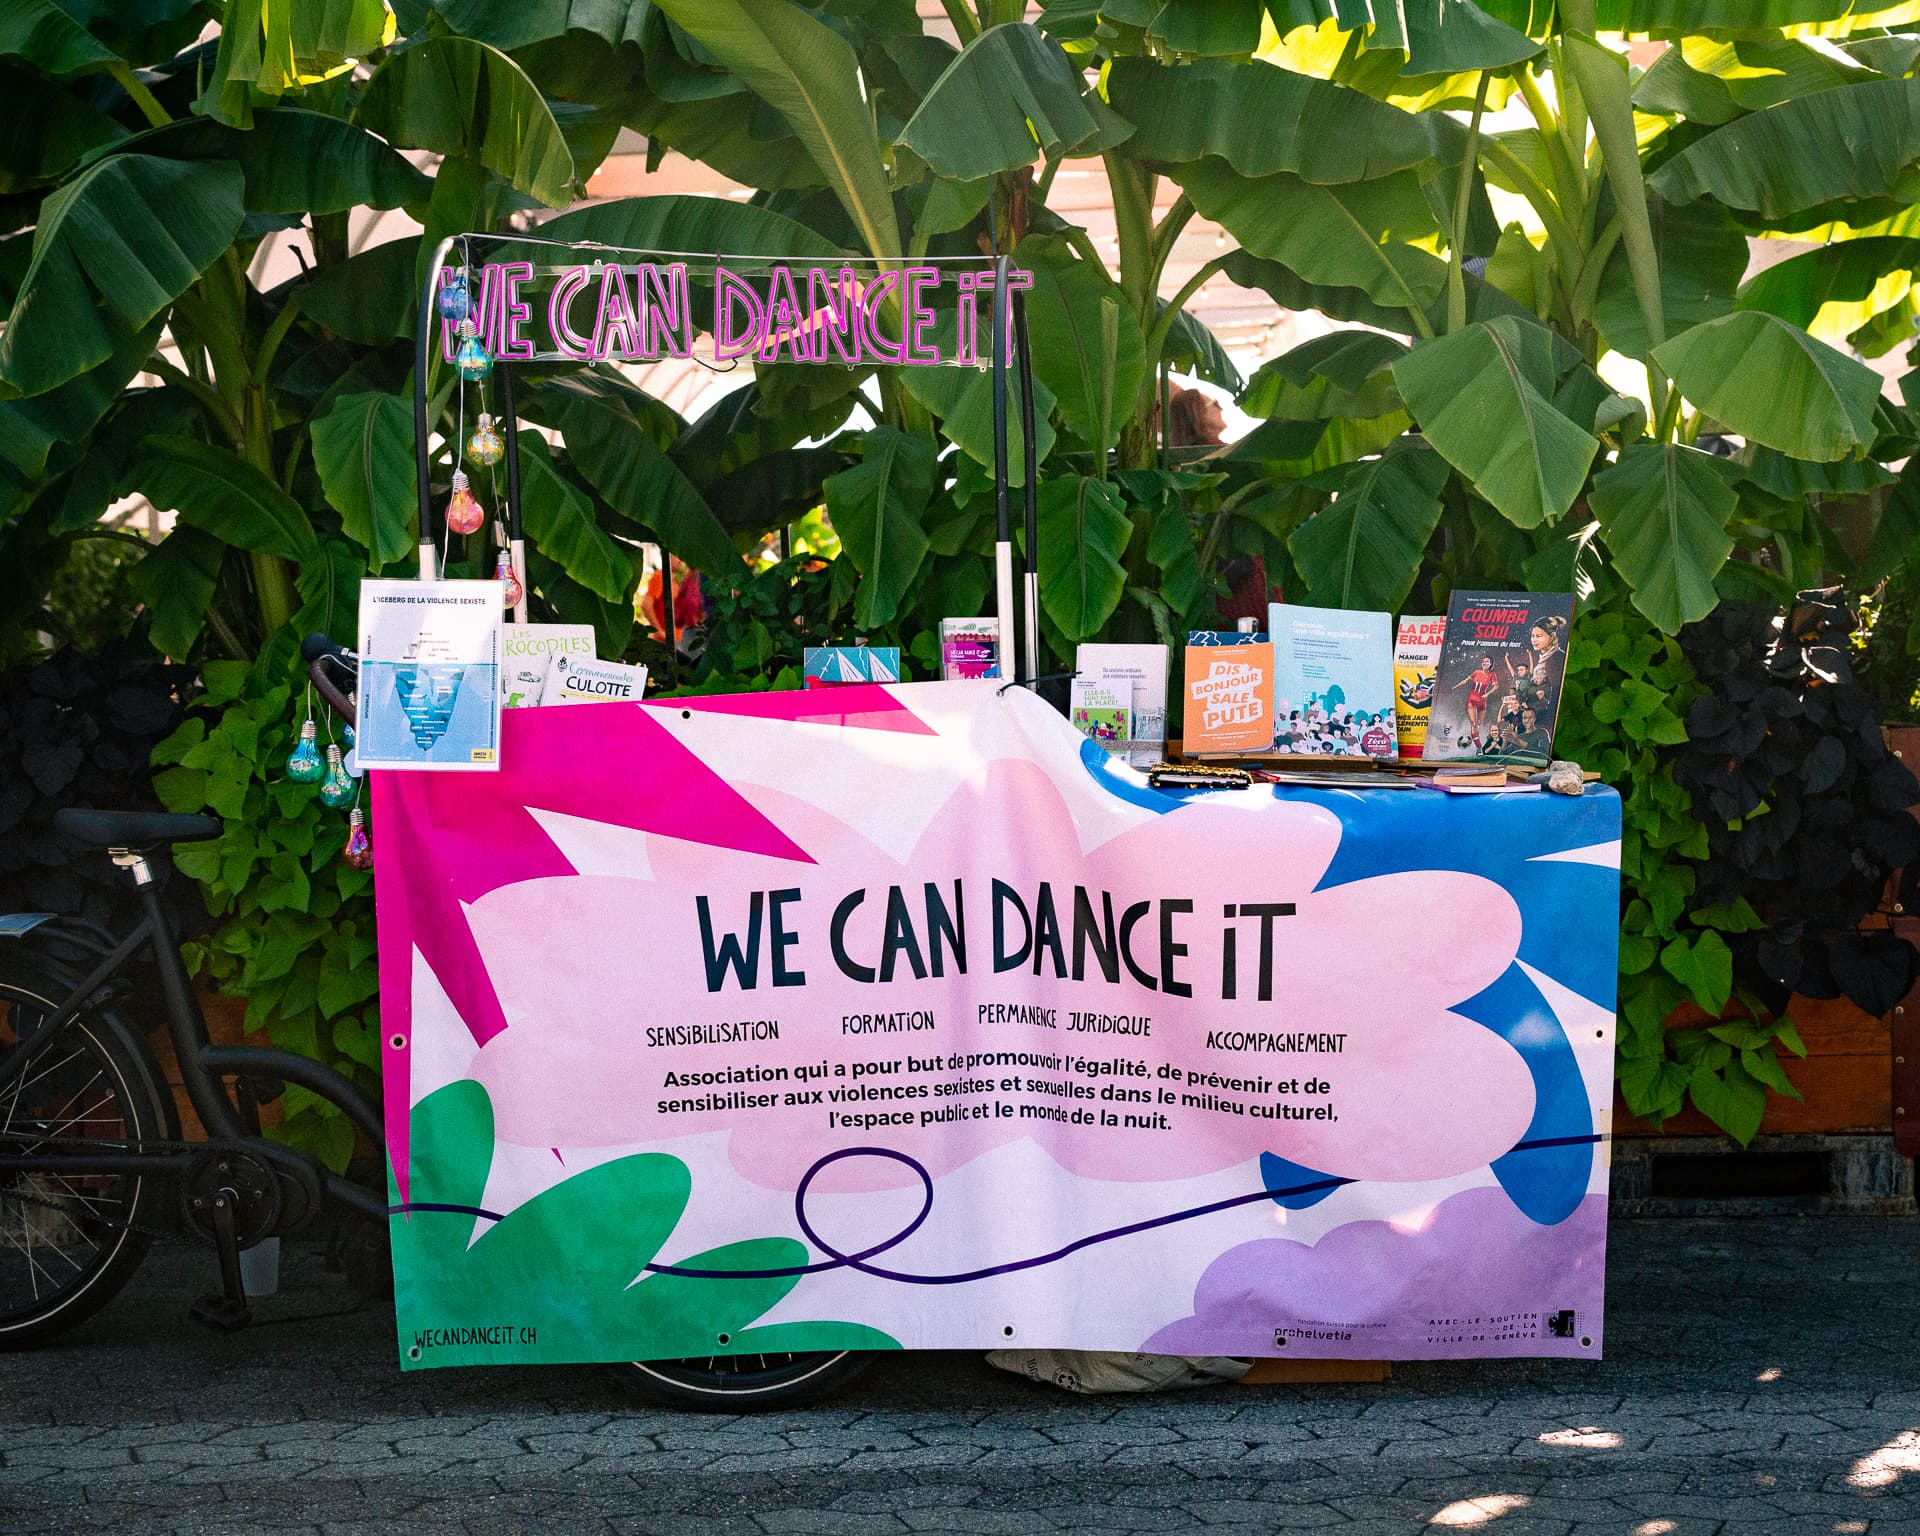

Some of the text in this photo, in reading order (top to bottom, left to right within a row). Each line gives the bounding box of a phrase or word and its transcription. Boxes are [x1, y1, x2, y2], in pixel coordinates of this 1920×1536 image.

[548, 262, 693, 361] CAN
[714, 265, 941, 365] DANCE
[373, 596, 405, 604] L'ICEBERG
[1461, 608, 1529, 624] COUMBA
[1398, 623, 1416, 634] LA
[1473, 624, 1510, 639] SOW
[505, 637, 591, 656] ROCODILES
[1215, 665, 1240, 675] DIS
[566, 676, 632, 697] CULOTTE
[1195, 673, 1258, 695] BONJOUR
[1210, 692, 1250, 704] SALE
[1207, 702, 1259, 727] PUTE
[696, 887, 807, 993] WE
[829, 877, 968, 984] CAN
[991, 877, 1194, 998] DANCE
[978, 1003, 1057, 1030] PERMANENCE
[1206, 1030, 1348, 1053] ACCOMPAGNEMENT
[664, 1065, 789, 1088] Association
[794, 1060, 829, 1083] qui
[834, 1063, 846, 1076] a
[852, 1060, 902, 1080] pour
[907, 1055, 944, 1073] but
[948, 1052, 964, 1070] de
[966, 1048, 1062, 1072] promouvoir
[1157, 1062, 1183, 1081] de
[1187, 1070, 1273, 1094] prévenir
[1278, 1079, 1299, 1094] et
[1304, 1077, 1331, 1094] de
[657, 1075, 1338, 1123] sensibiliser aux violences sexistes et sexuelles dans le milieu culturel,
[920, 1103, 969, 1128] public
[972, 1103, 990, 1119] et
[995, 1100, 1014, 1118] le
[1019, 1104, 1068, 1123] monde
[1071, 1108, 1095, 1125] de
[1101, 1108, 1119, 1127] la
[1124, 1111, 1172, 1131] nuit.
[1297, 1318, 1325, 1326] fondation
[1429, 1313, 1537, 1326] AVEC LE SOUTIEN
[1274, 1328, 1352, 1341] prohelvetia
[1427, 1335, 1463, 1343] VILLE
[1494, 1330, 1536, 1341] GENÈVE
